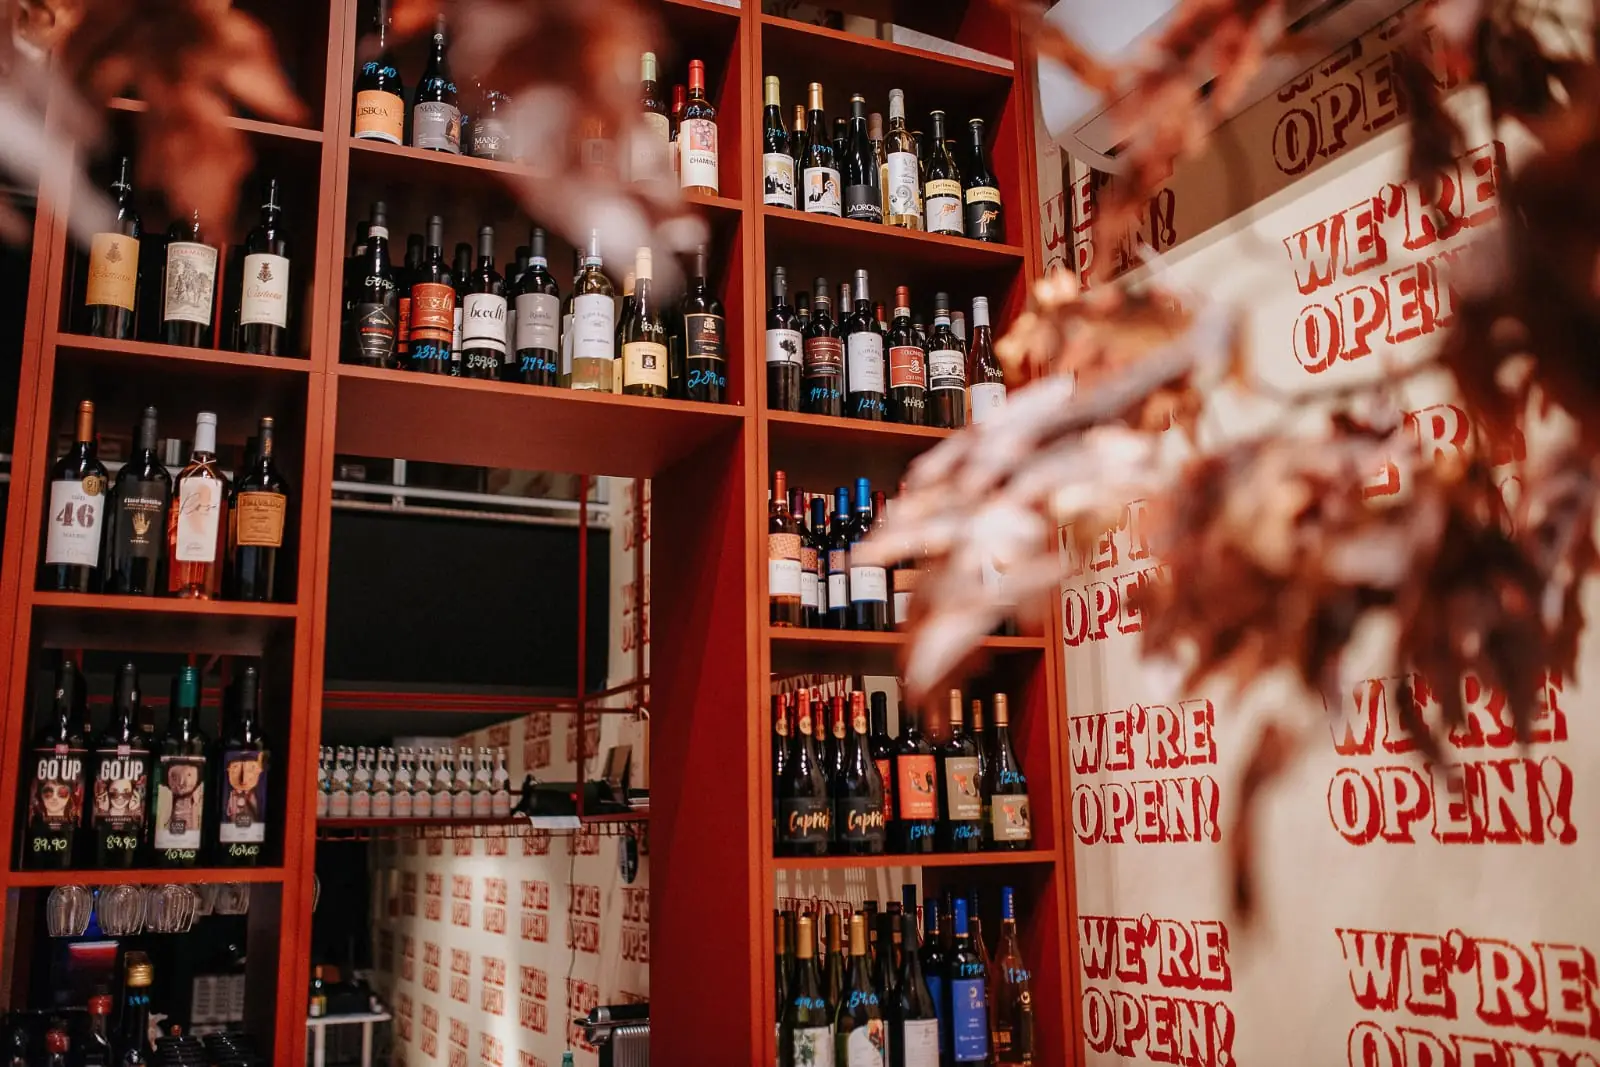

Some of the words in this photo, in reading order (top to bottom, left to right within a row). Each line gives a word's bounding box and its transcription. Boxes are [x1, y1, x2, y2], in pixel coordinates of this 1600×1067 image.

[56, 501, 95, 529] 46
[37, 759, 58, 780] GO
[61, 759, 82, 780] UP
[101, 760, 121, 781] GO
[124, 760, 144, 780] UP
[1068, 699, 1217, 774] WE'RE
[1072, 774, 1222, 846] OPEN!
[1327, 755, 1578, 846] OPEN!
[33, 838, 68, 852] 89,90
[106, 835, 137, 850] 89,90
[1078, 913, 1233, 993] WE'RE
[1335, 928, 1600, 1041] WE'RE
[1082, 987, 1237, 1067] OPEN!
